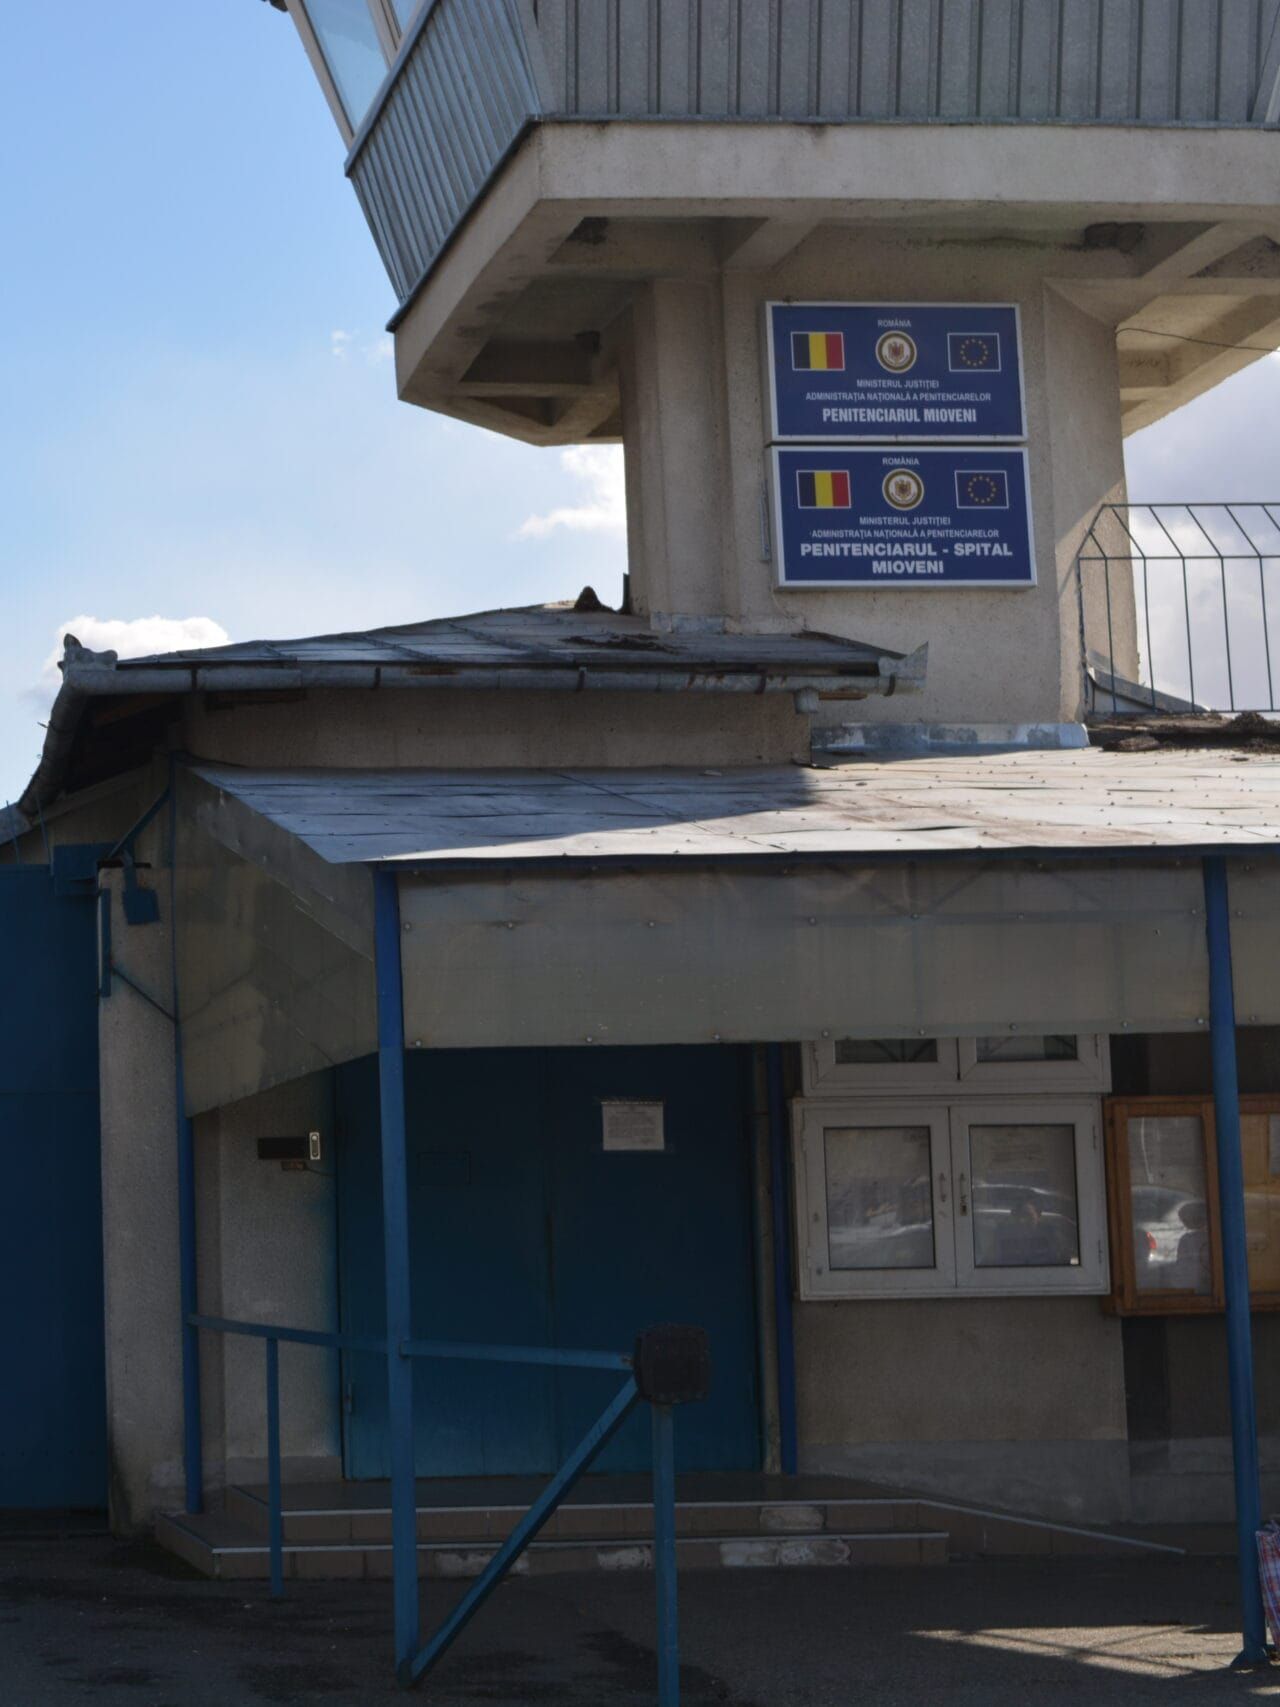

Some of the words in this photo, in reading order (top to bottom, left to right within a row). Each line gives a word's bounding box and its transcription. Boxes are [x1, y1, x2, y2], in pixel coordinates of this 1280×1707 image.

[877, 318, 912, 328] ROMÂNIA
[856, 379, 903, 389] MINISTERUL
[912, 393, 919, 401] A
[919, 392, 992, 401] PENITENCIARELOR
[822, 407, 920, 422] PENITENCIARUL
[923, 408, 977, 423] MIOVENI
[882, 456, 920, 465] ROMÂNIA
[859, 516, 910, 525] MINISTERUL
[919, 530, 926, 538] A
[926, 529, 999, 538] PENITENCIARELOR
[800, 543, 937, 557] PENITENCIARUL
[953, 543, 1013, 557] SPITAL
[872, 560, 944, 574] MIOVENI
